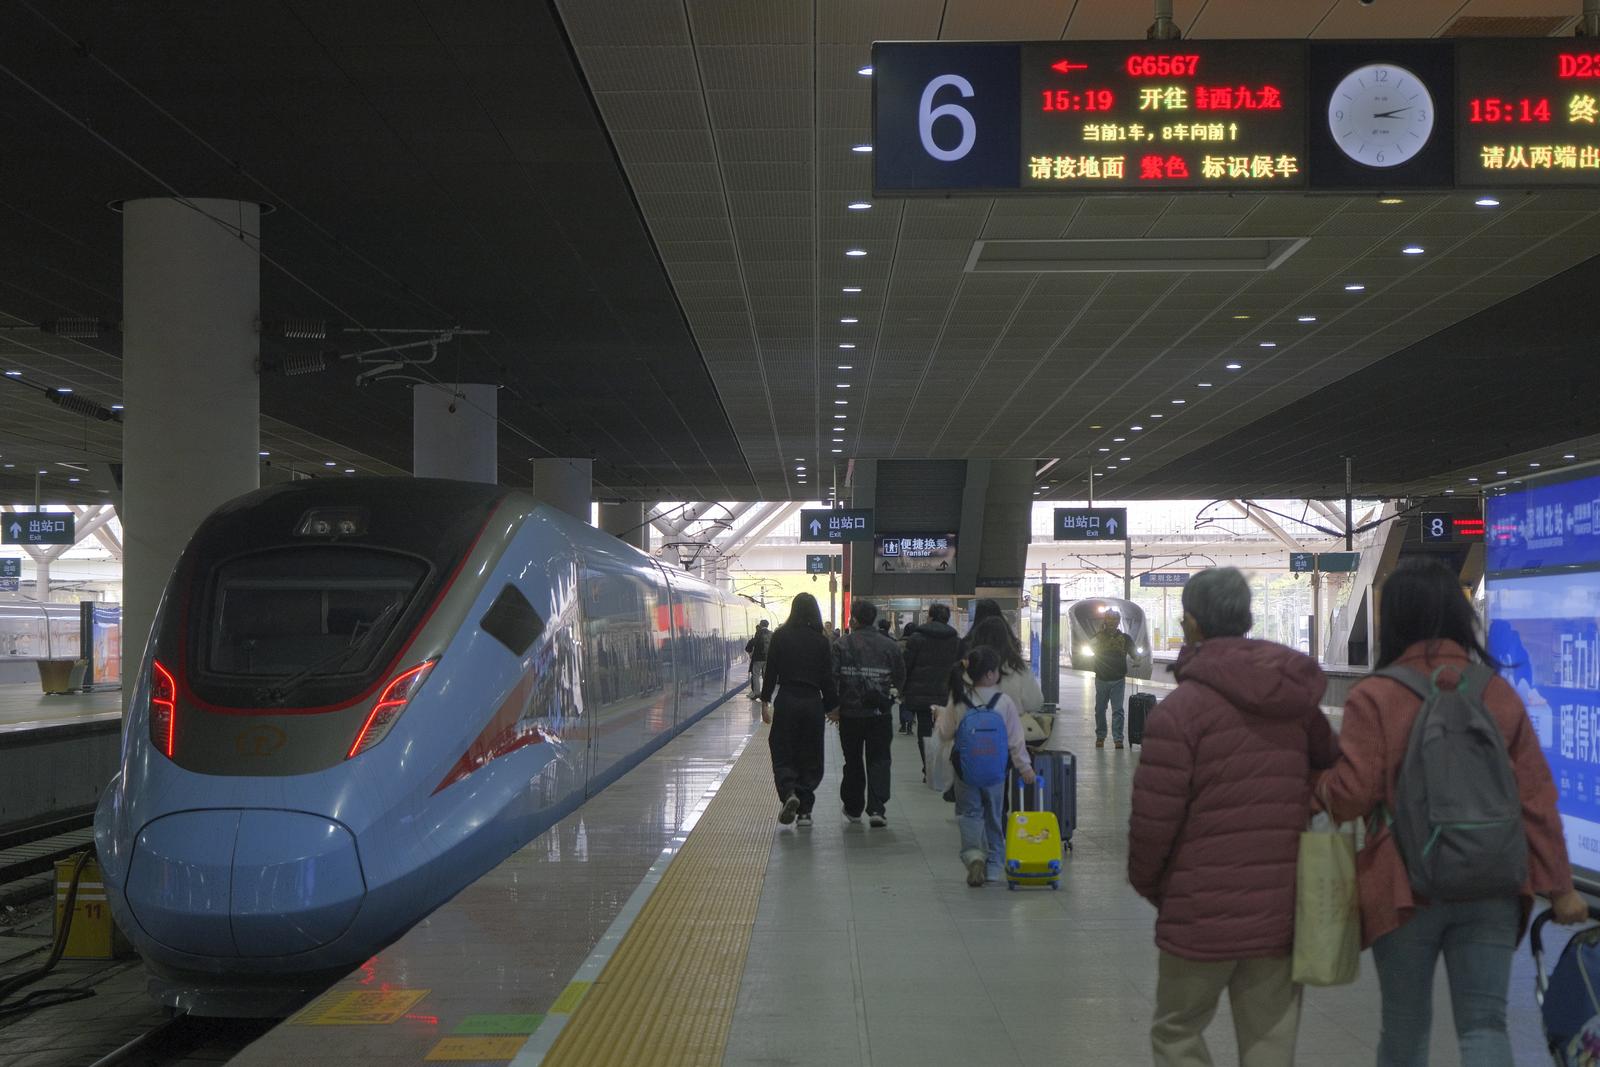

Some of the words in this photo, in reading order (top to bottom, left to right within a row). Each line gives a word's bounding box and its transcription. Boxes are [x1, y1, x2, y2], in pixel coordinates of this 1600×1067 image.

[1127, 55, 1199, 77] G6567
[1375, 70, 1388, 82] 12
[1042, 90, 1113, 111] 15:19
[1139, 87, 1188, 110] 开往
[1336, 109, 1344, 121] 9
[1418, 109, 1426, 121] 3
[1470, 99, 1551, 123] 15:14
[919, 74, 976, 162] 6
[1376, 150, 1385, 163] 6
[1480, 146, 1600, 169] 请从两端出
[1028, 156, 1125, 179] 请按地面
[1140, 156, 1189, 179] 紫色
[1202, 155, 1298, 178] 标识候车
[29, 520, 65, 532] 出站口
[829, 516, 865, 529] 出站口
[1063, 516, 1100, 528] 出站口
[1431, 518, 1444, 537] 8
[899, 538, 948, 550] 便捷换乘
[902, 550, 931, 558] Transfer
